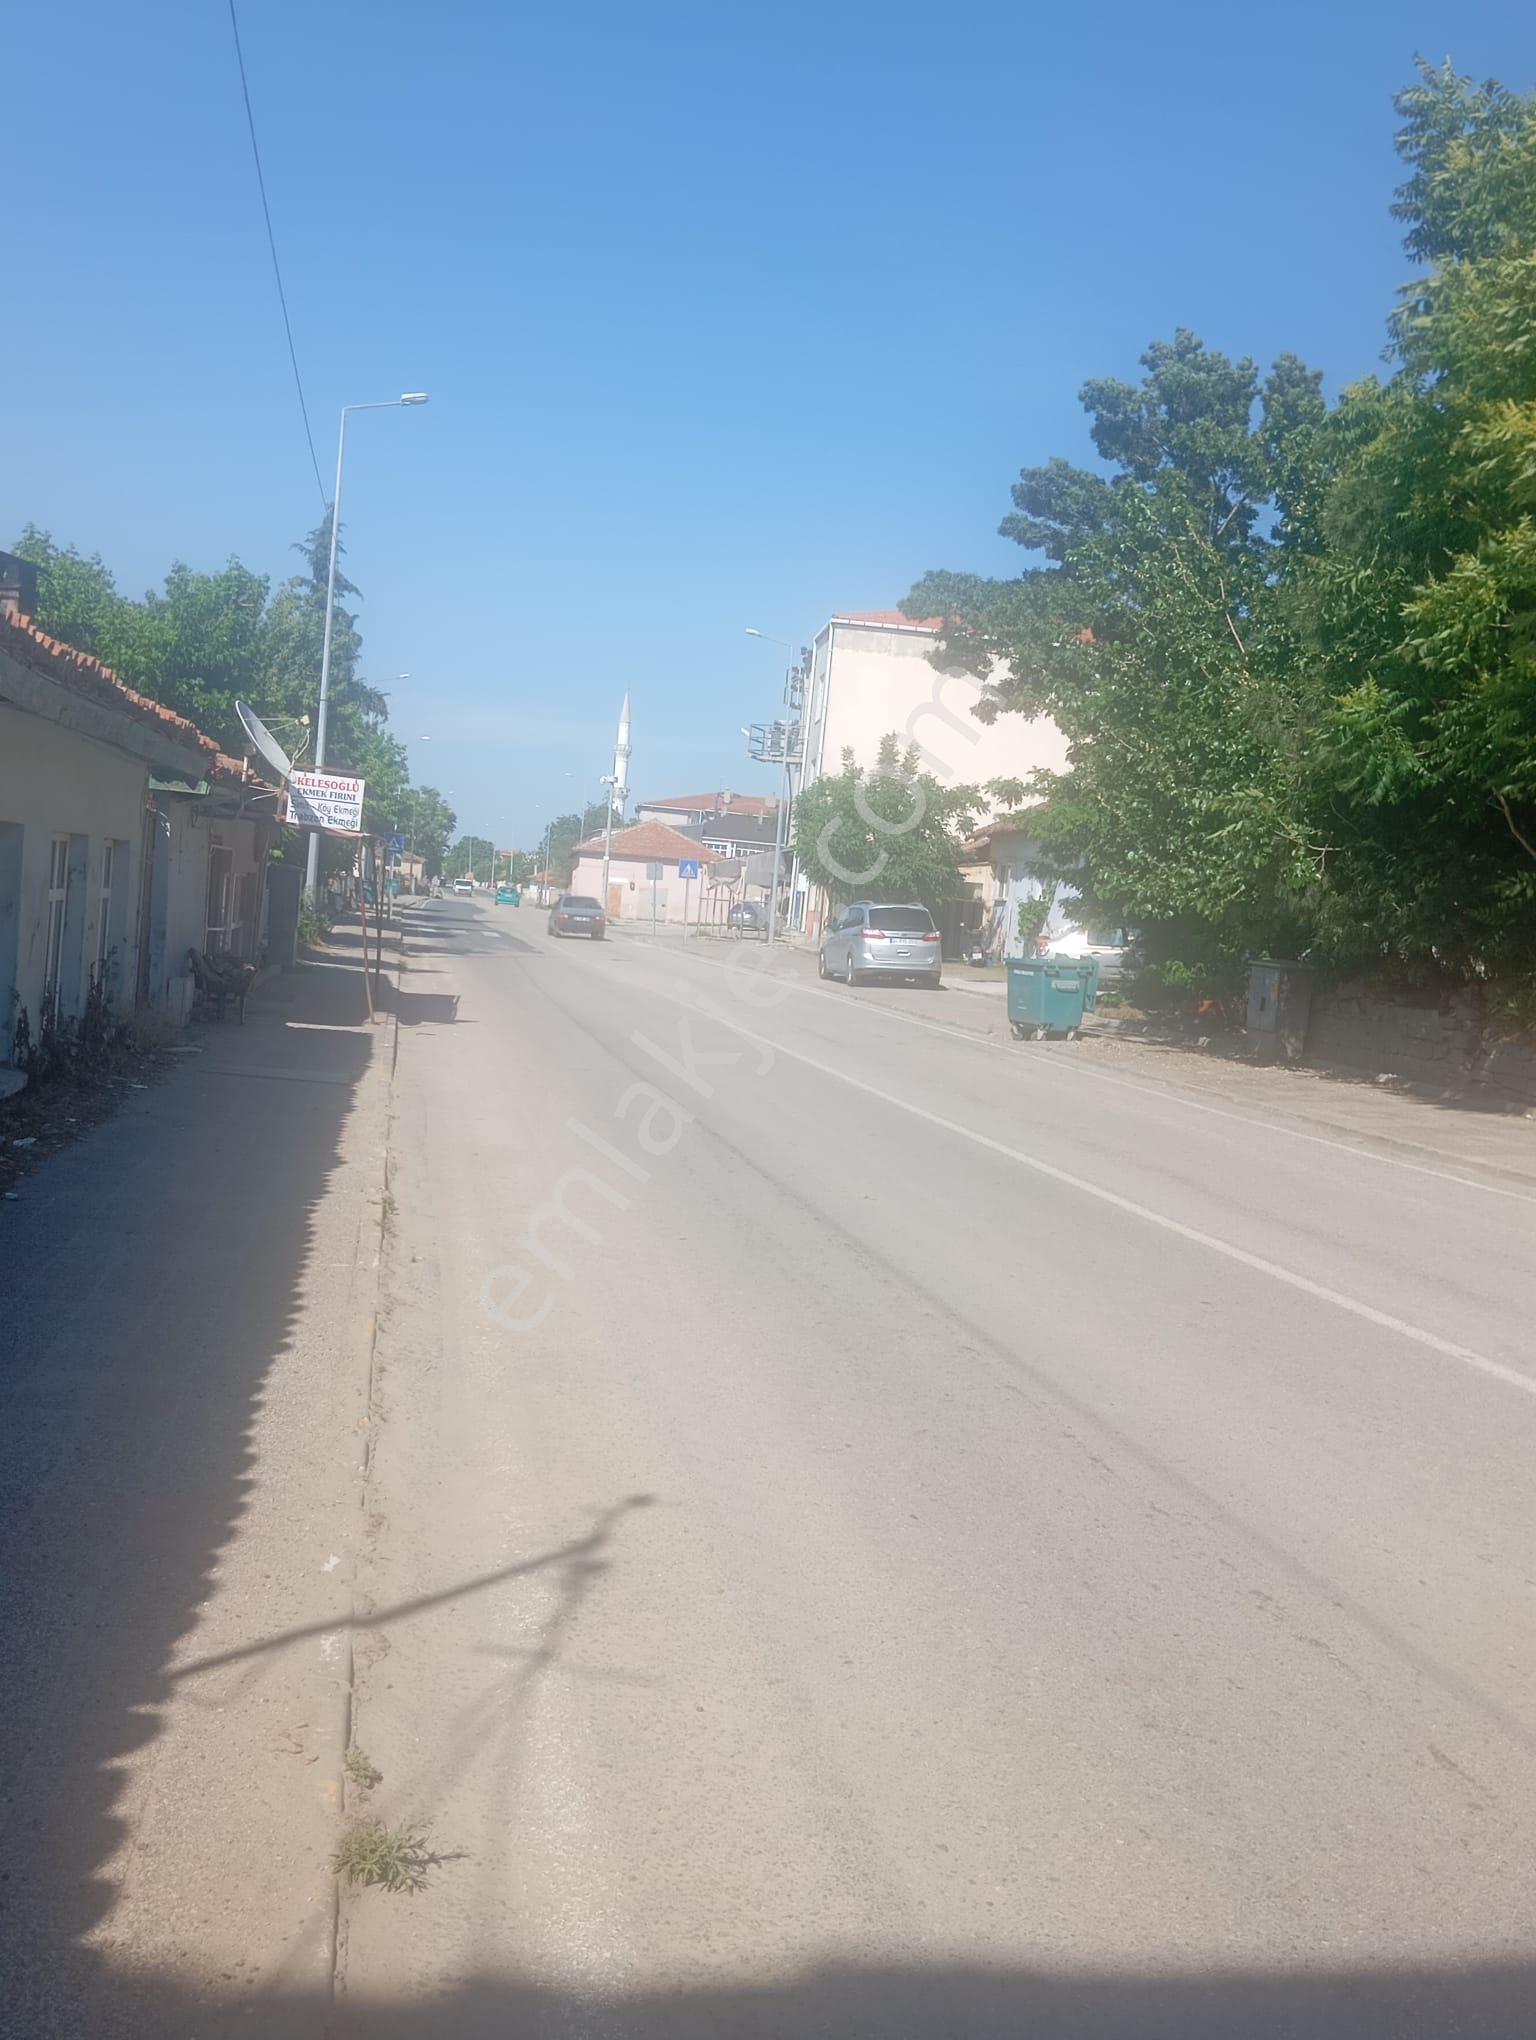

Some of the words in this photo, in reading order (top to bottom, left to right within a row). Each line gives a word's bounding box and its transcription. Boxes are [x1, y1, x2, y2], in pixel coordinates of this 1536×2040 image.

[297, 787, 327, 798] EKMEK
[329, 791, 356, 801] FIRINI
[289, 810, 325, 824] Trabzon
